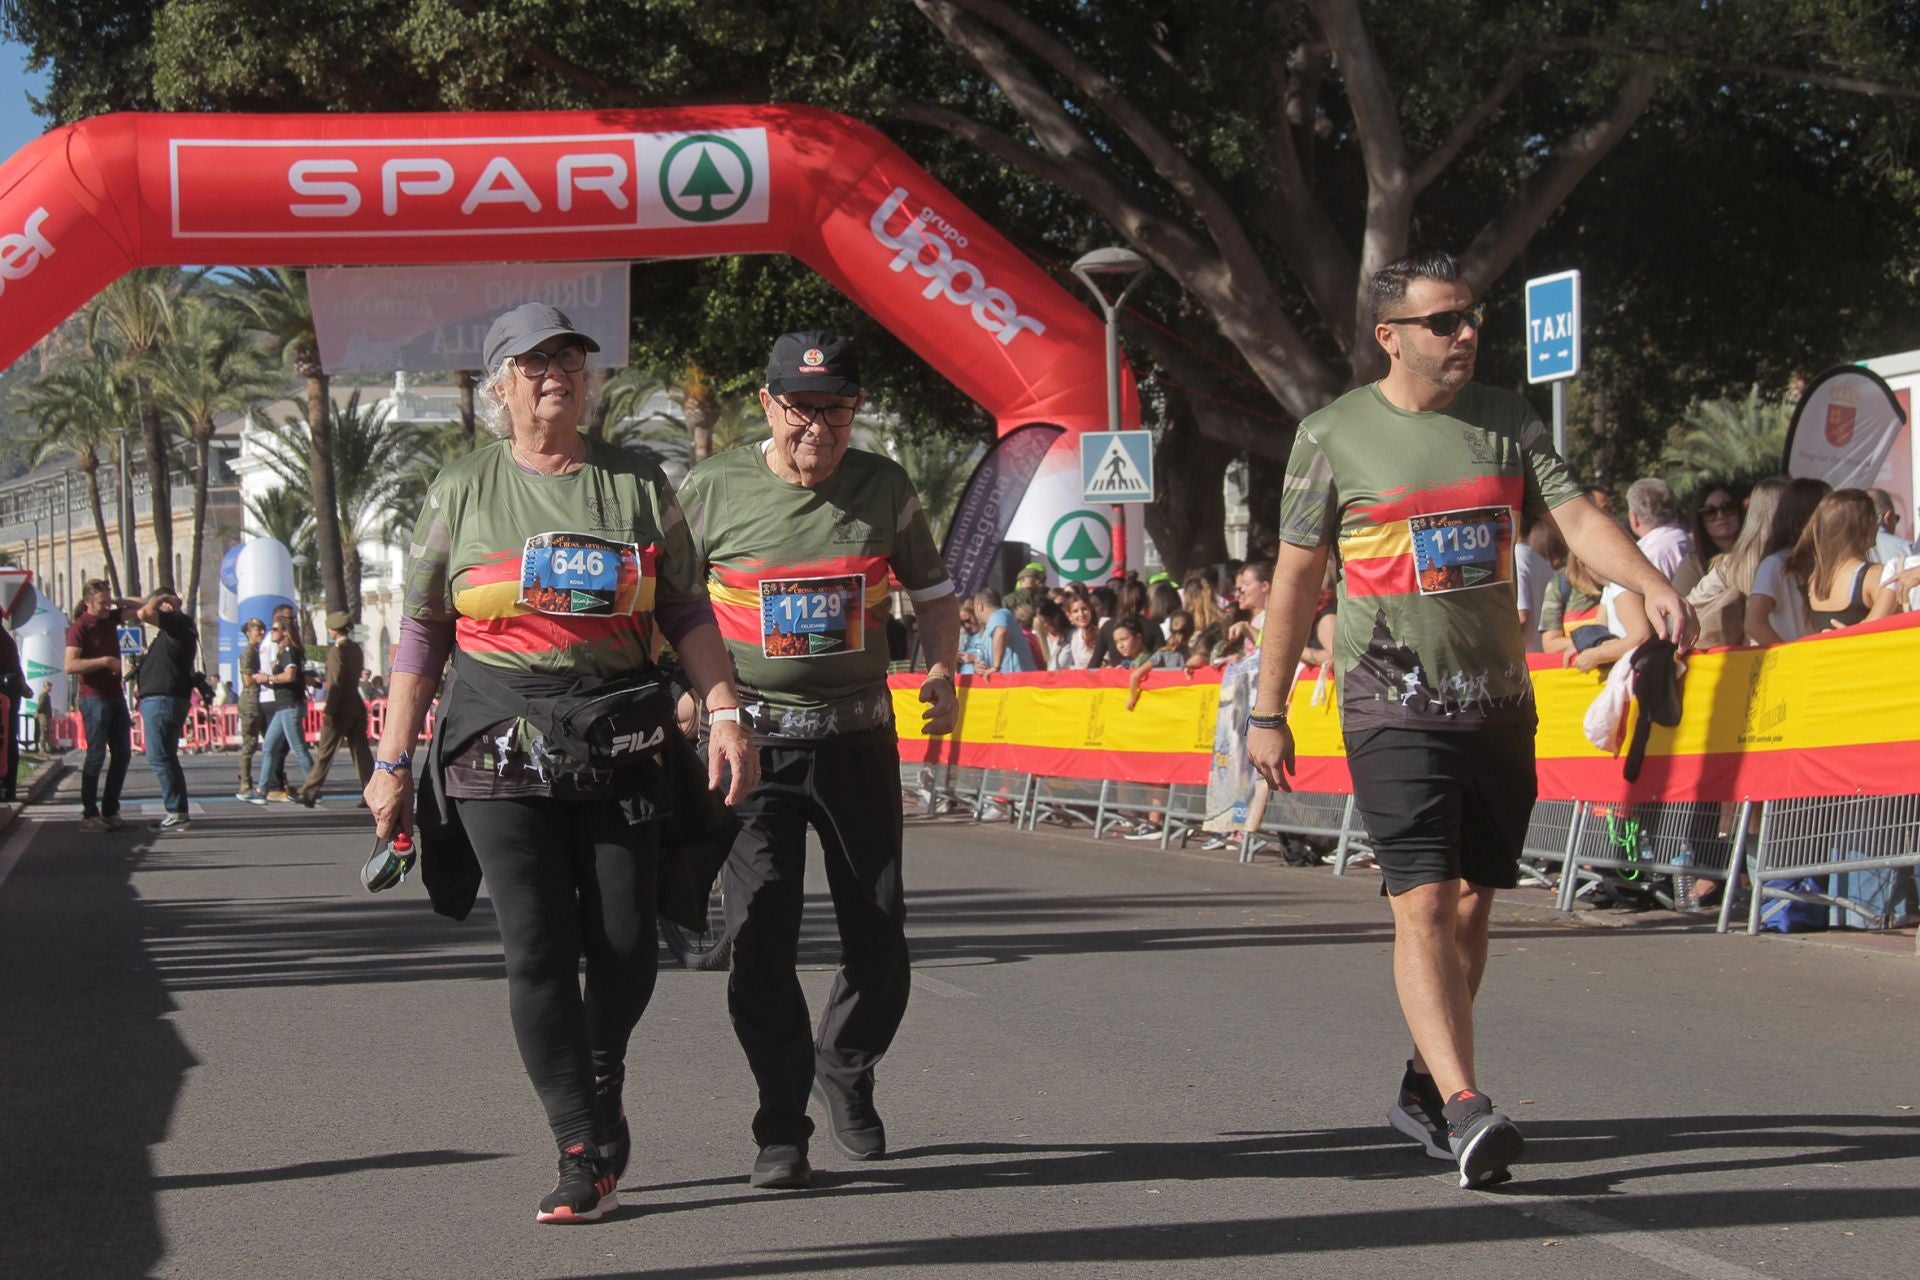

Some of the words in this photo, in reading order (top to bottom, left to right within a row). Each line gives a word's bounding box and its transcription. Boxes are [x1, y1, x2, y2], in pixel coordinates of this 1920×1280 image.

[288, 152, 630, 218] SPAR
[919, 206, 969, 248] grupo
[0, 206, 56, 297] er
[870, 186, 1047, 346] Upper
[1531, 312, 1572, 344] TAXI
[954, 474, 1010, 599] Cartagena
[1432, 524, 1490, 554] 1130
[551, 550, 603, 576] 646
[779, 593, 841, 620] 1129
[611, 726, 665, 758] FILA
